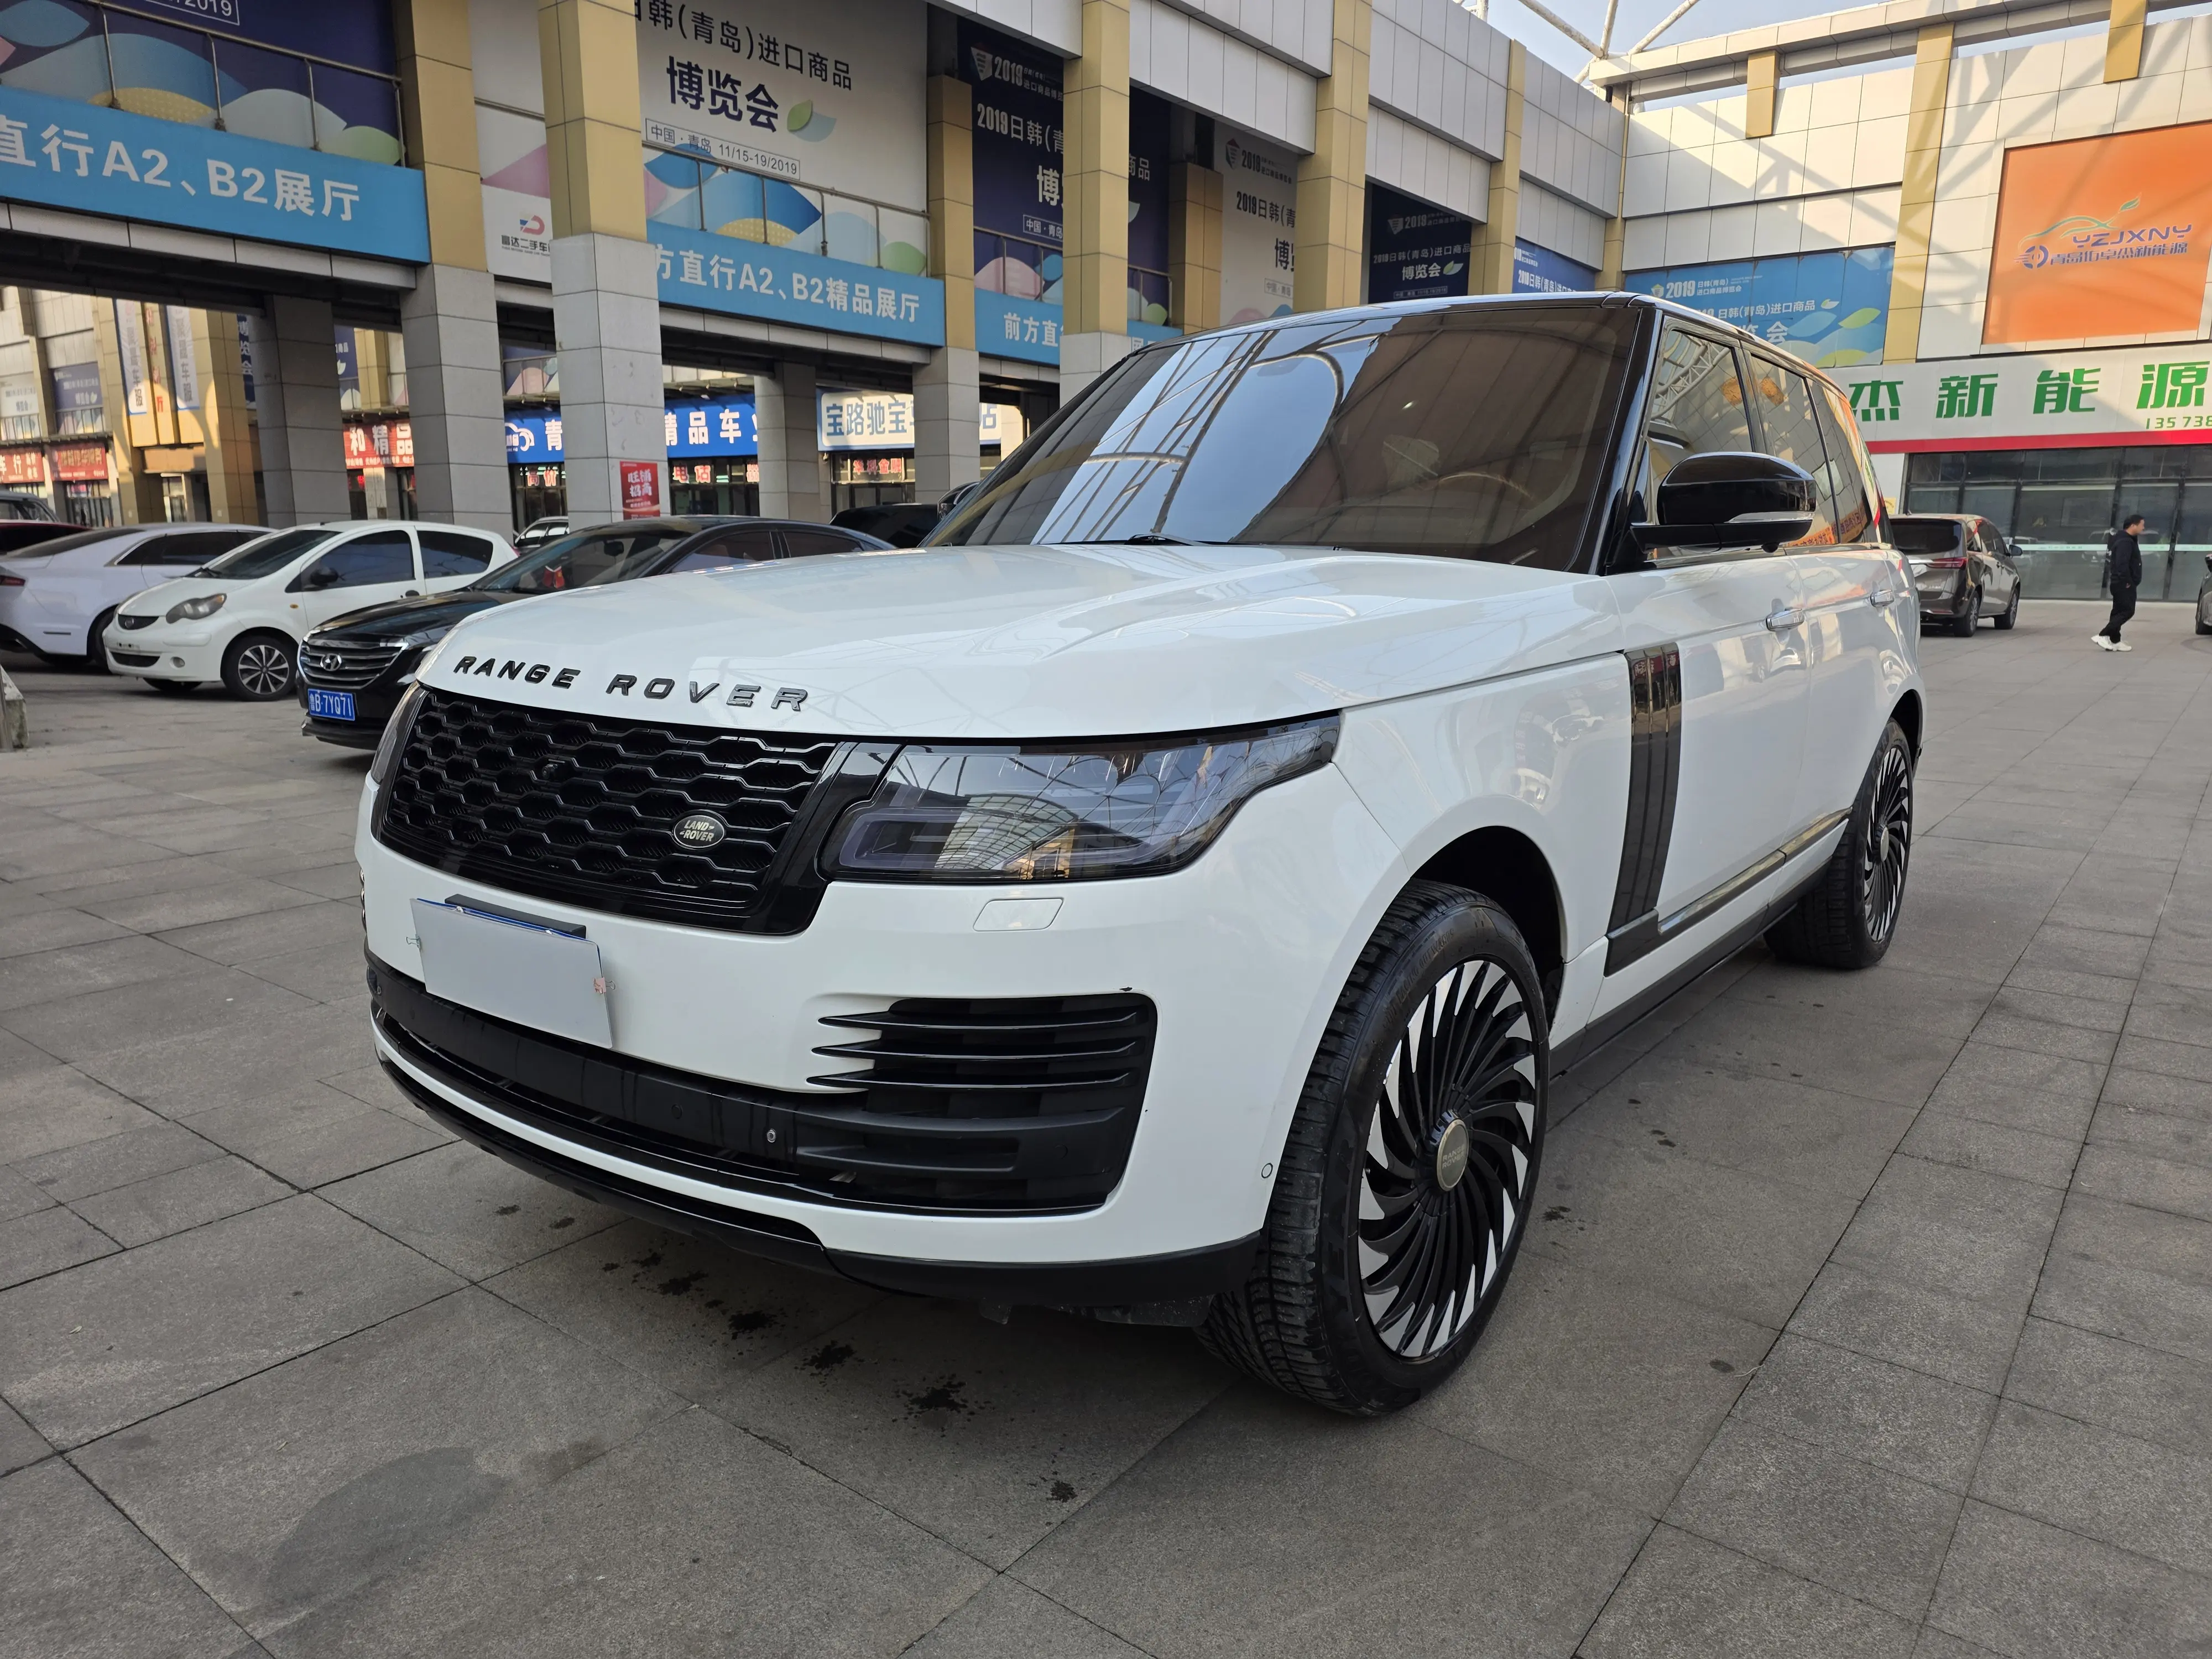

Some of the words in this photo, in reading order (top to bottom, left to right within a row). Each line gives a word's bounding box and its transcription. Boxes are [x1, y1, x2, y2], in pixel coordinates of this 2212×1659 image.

[994, 56, 1023, 86] 2019
[666, 55, 779, 133] 博览会
[719, 143, 797, 174] 11/15-19/2019
[1037, 165, 1063, 208] 博
[501, 235, 550, 252] 富达二手车
[2073, 224, 2192, 248] YZJXNY
[1402, 263, 1441, 280] 博览会
[1665, 280, 1695, 299] 2019
[1004, 312, 1063, 347] 前方直
[1849, 361, 2210, 422] 杰新能源
[826, 400, 914, 436] 宝路驰宝
[453, 656, 581, 689] RANGE
[606, 674, 808, 712] ROVER
[683, 830, 714, 842] ROVER
[684, 820, 710, 831] LAND
